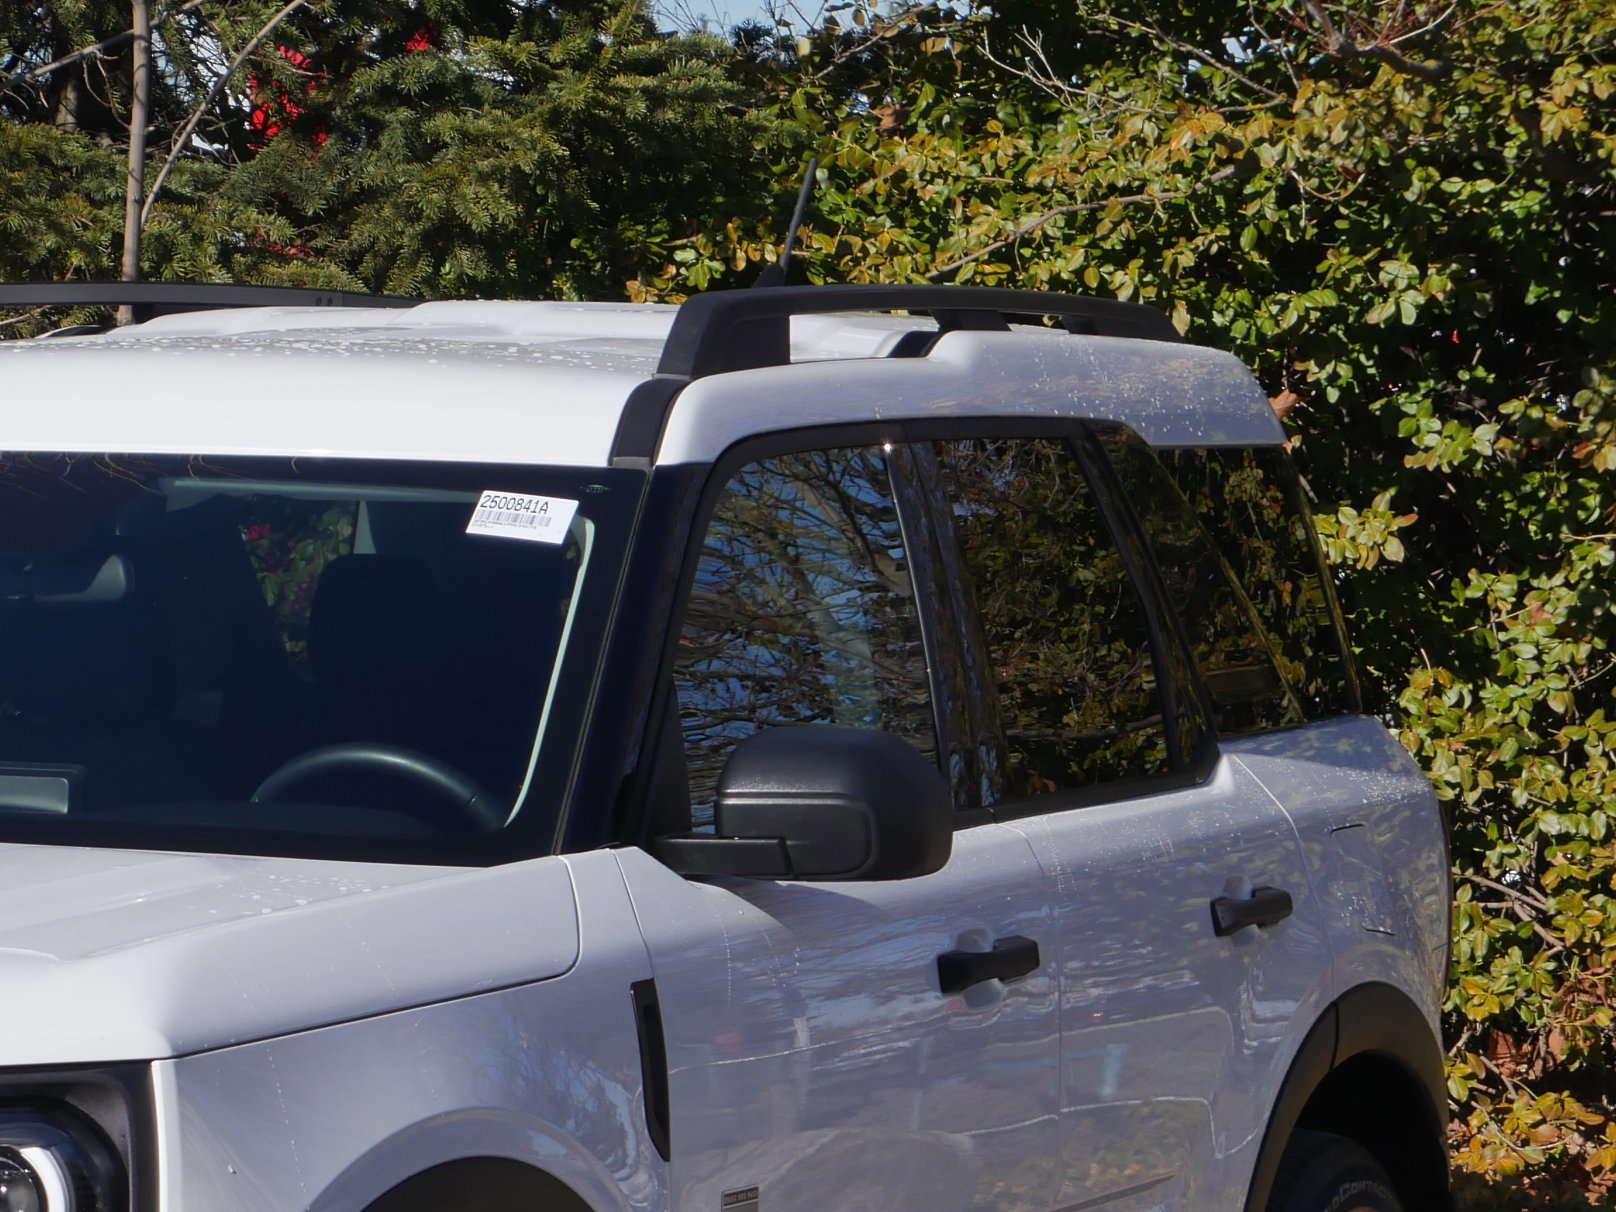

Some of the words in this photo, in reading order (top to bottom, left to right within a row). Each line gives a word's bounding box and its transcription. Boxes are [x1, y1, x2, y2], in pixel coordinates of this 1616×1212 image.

[480, 494, 549, 515] 2500841A
[724, 1195, 737, 1204] BIG
[737, 1190, 758, 1201] BEND
